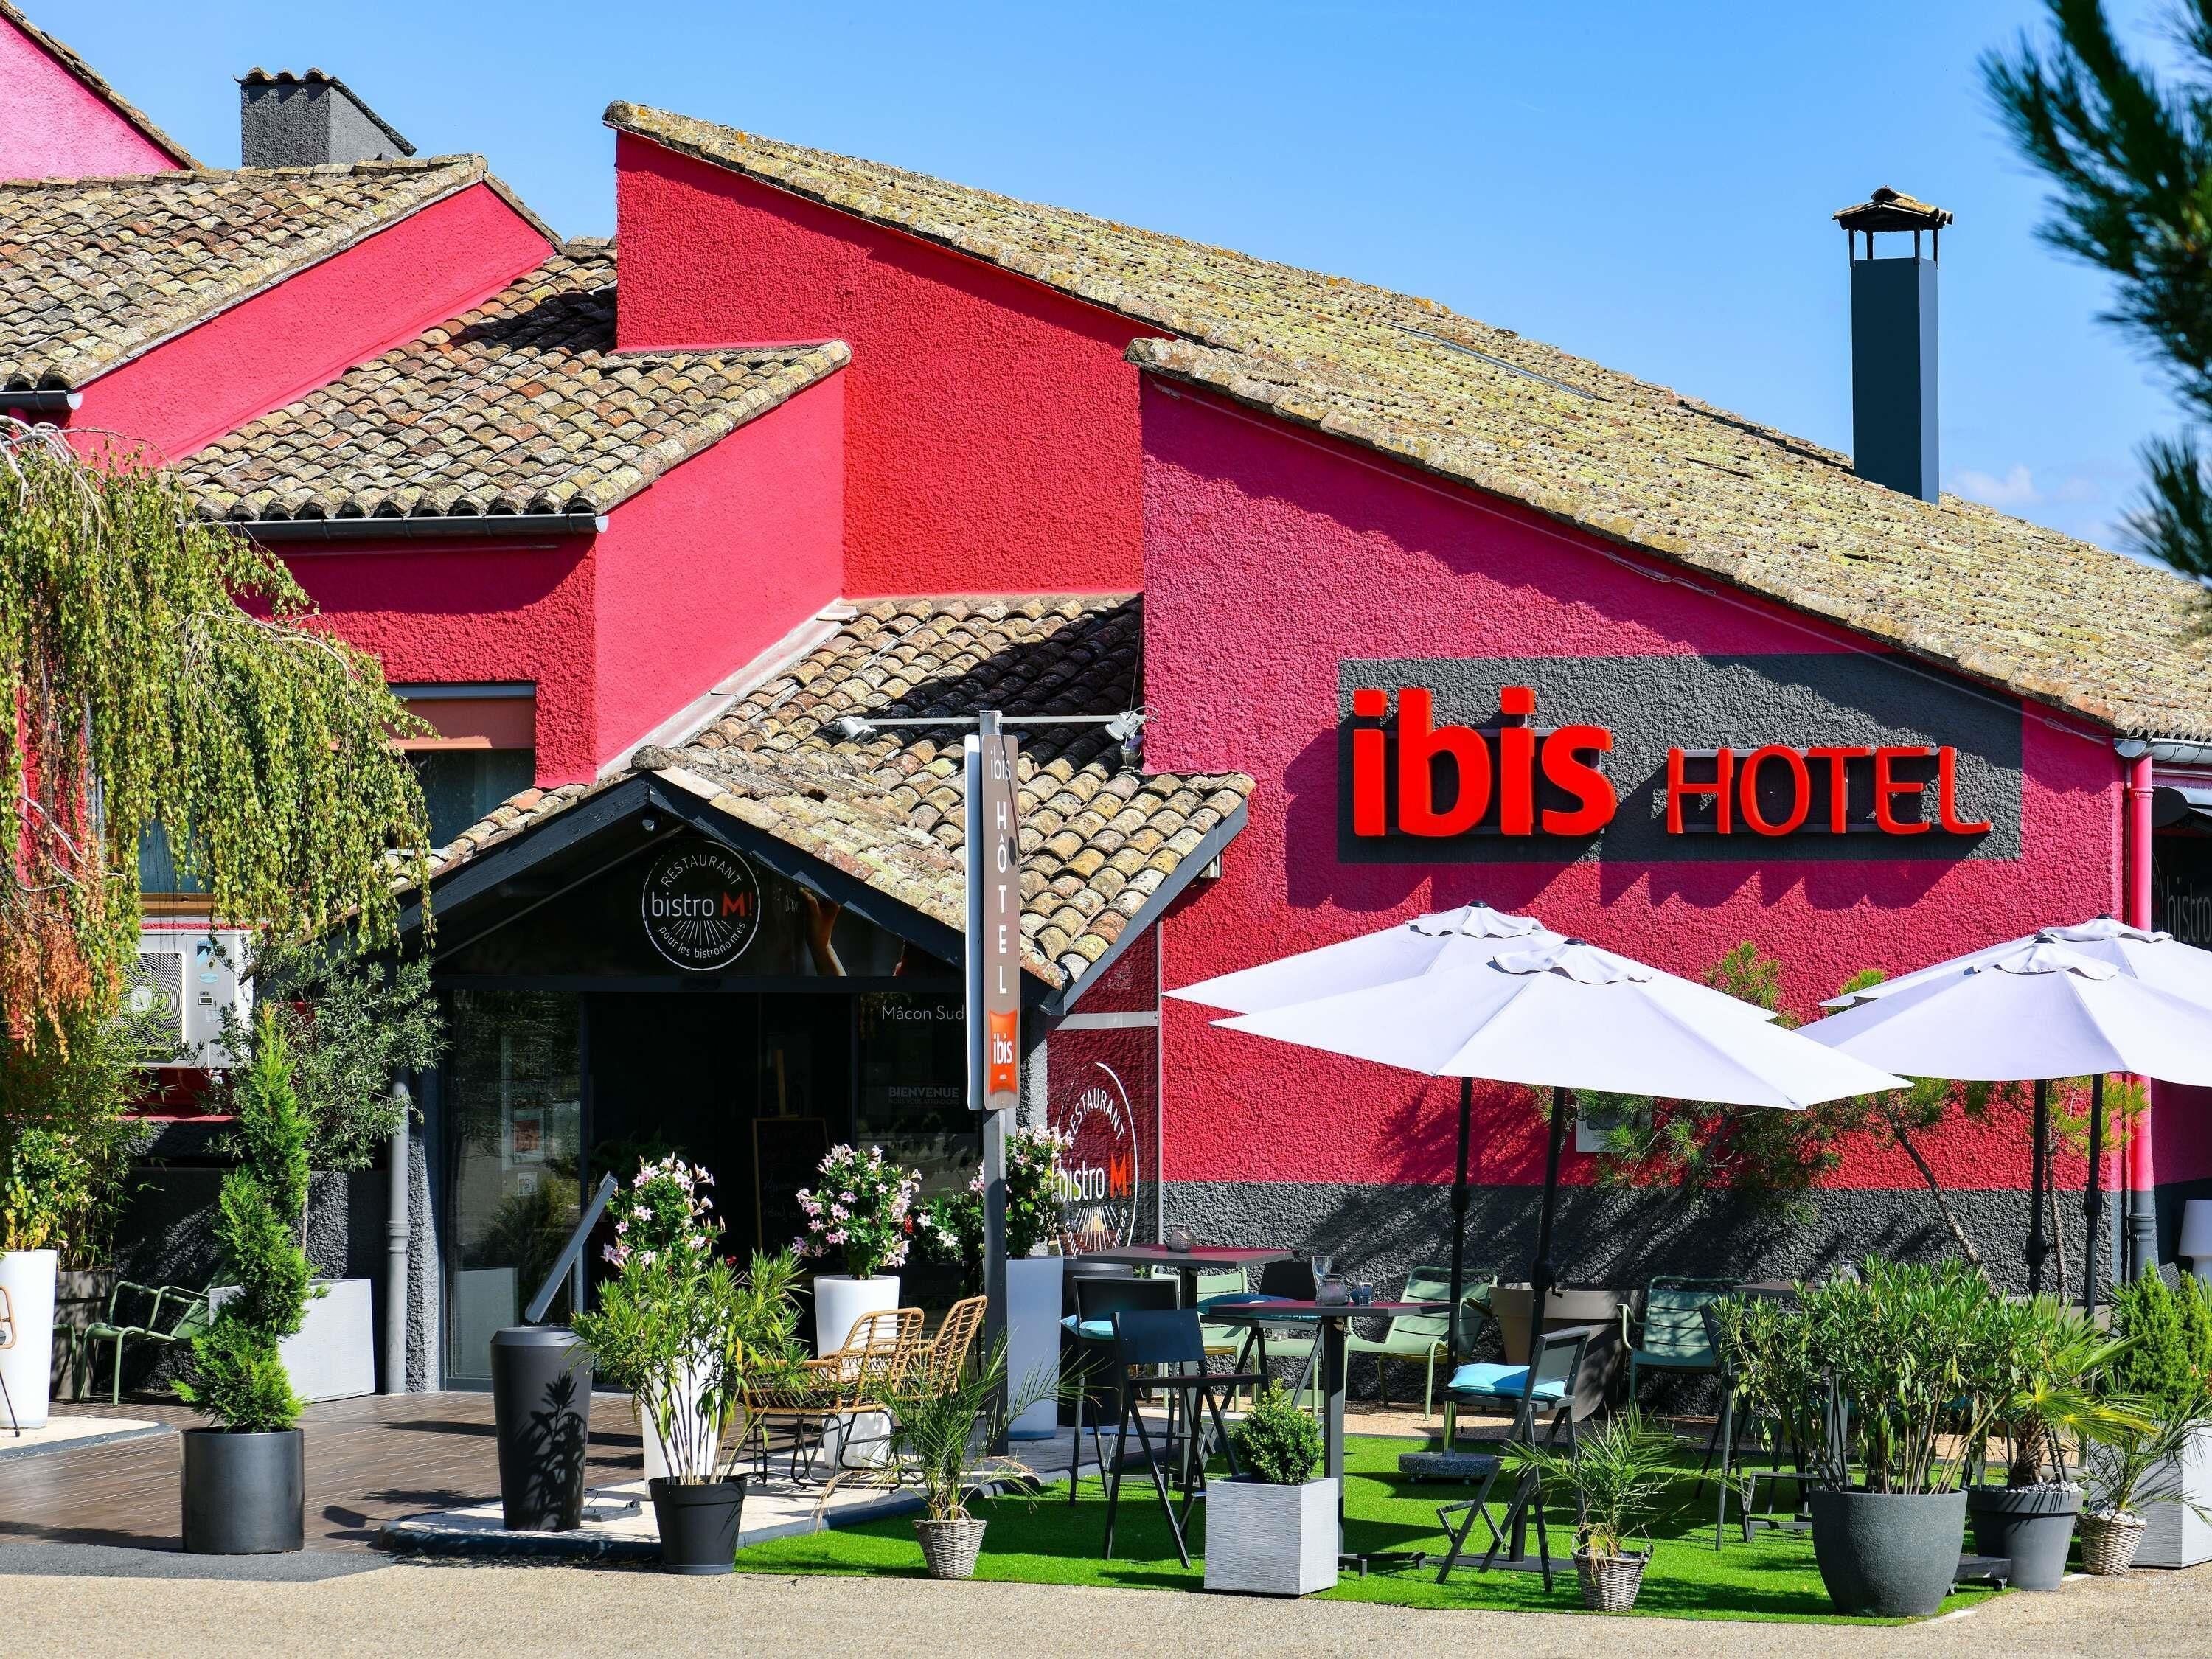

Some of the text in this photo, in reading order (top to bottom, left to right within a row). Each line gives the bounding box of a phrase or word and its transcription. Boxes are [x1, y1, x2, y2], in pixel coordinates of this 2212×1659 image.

[990, 746, 1011, 780] ibis
[1353, 686, 1992, 837] ibis HOTEL
[661, 854, 742, 888] RESTAURANT
[651, 891, 714, 917] bistro
[996, 801, 1008, 994] HÔTEL
[658, 922, 746, 959] pour les bistronomes
[882, 1004, 964, 1020] Mâcon Sud
[993, 1032, 1013, 1065] ibis
[888, 1086, 960, 1098] BIENVENUE
[1058, 1158, 1105, 1203] bistro
